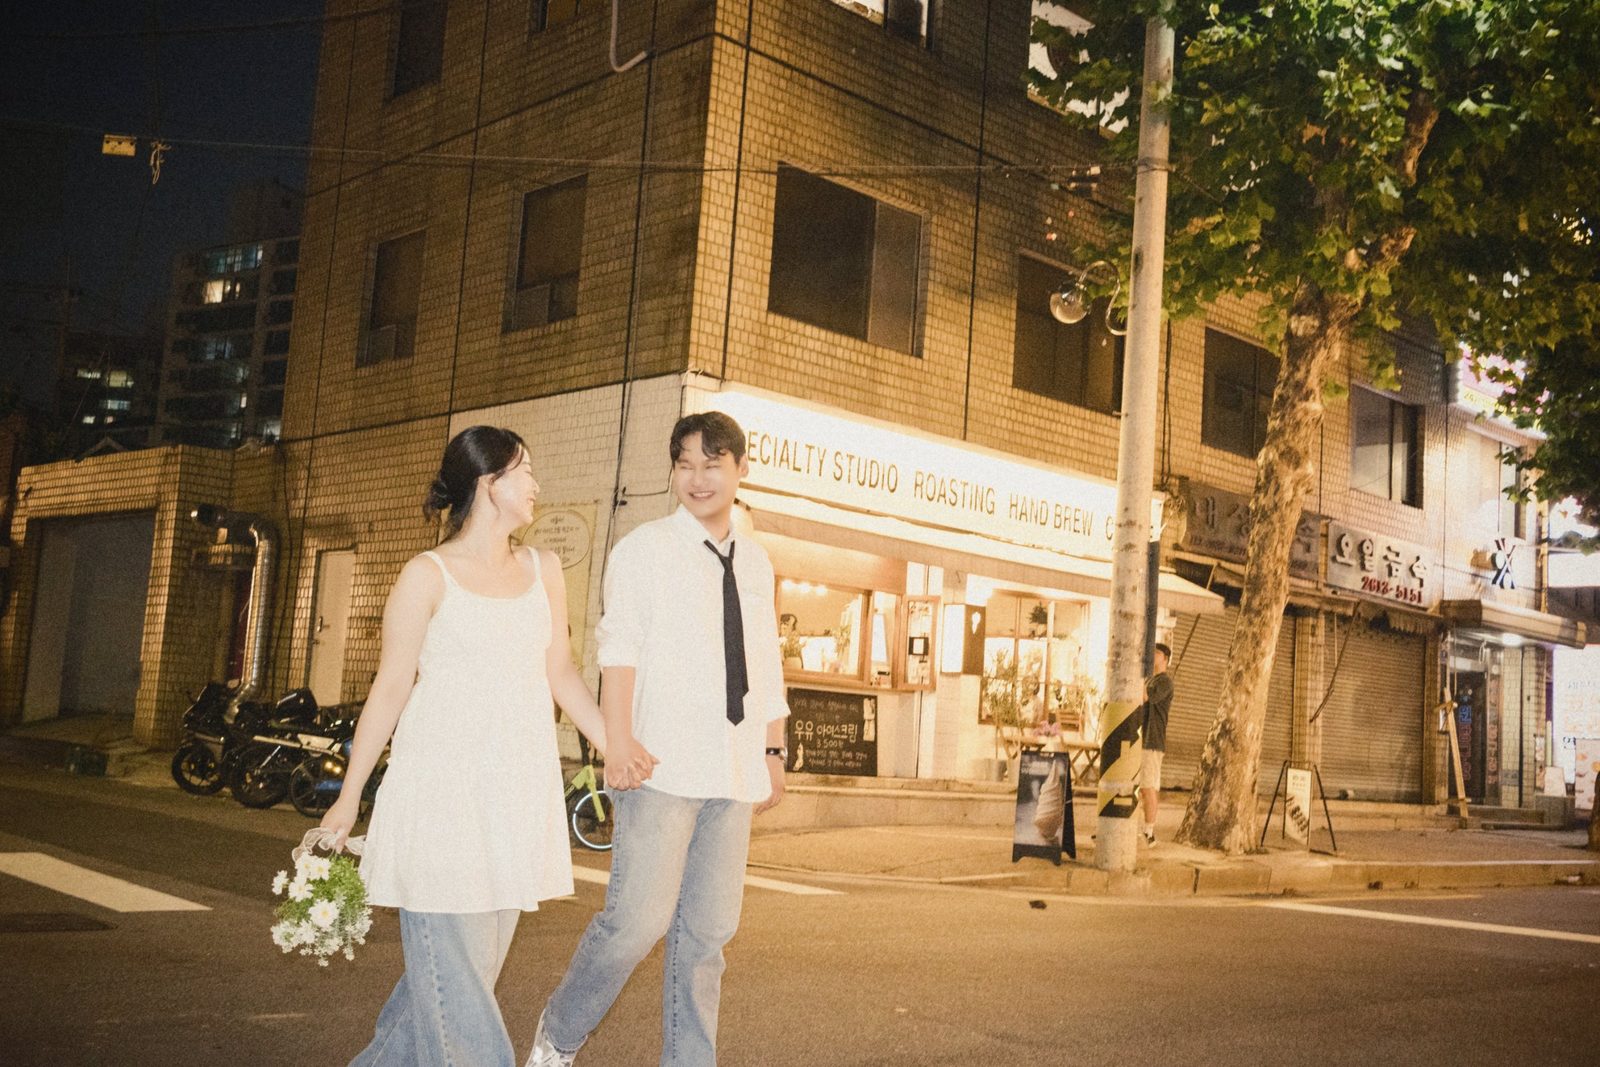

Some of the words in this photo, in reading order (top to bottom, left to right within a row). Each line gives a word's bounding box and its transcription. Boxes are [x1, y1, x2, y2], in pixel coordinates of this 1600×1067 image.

[832, 450, 899, 494] STUDIO
[913, 470, 996, 515] ROASTING
[1008, 492, 1049, 527] HAND
[1053, 503, 1094, 537] BREW
[794, 719, 814, 742] 우유
[816, 723, 858, 744] 아이스크림
